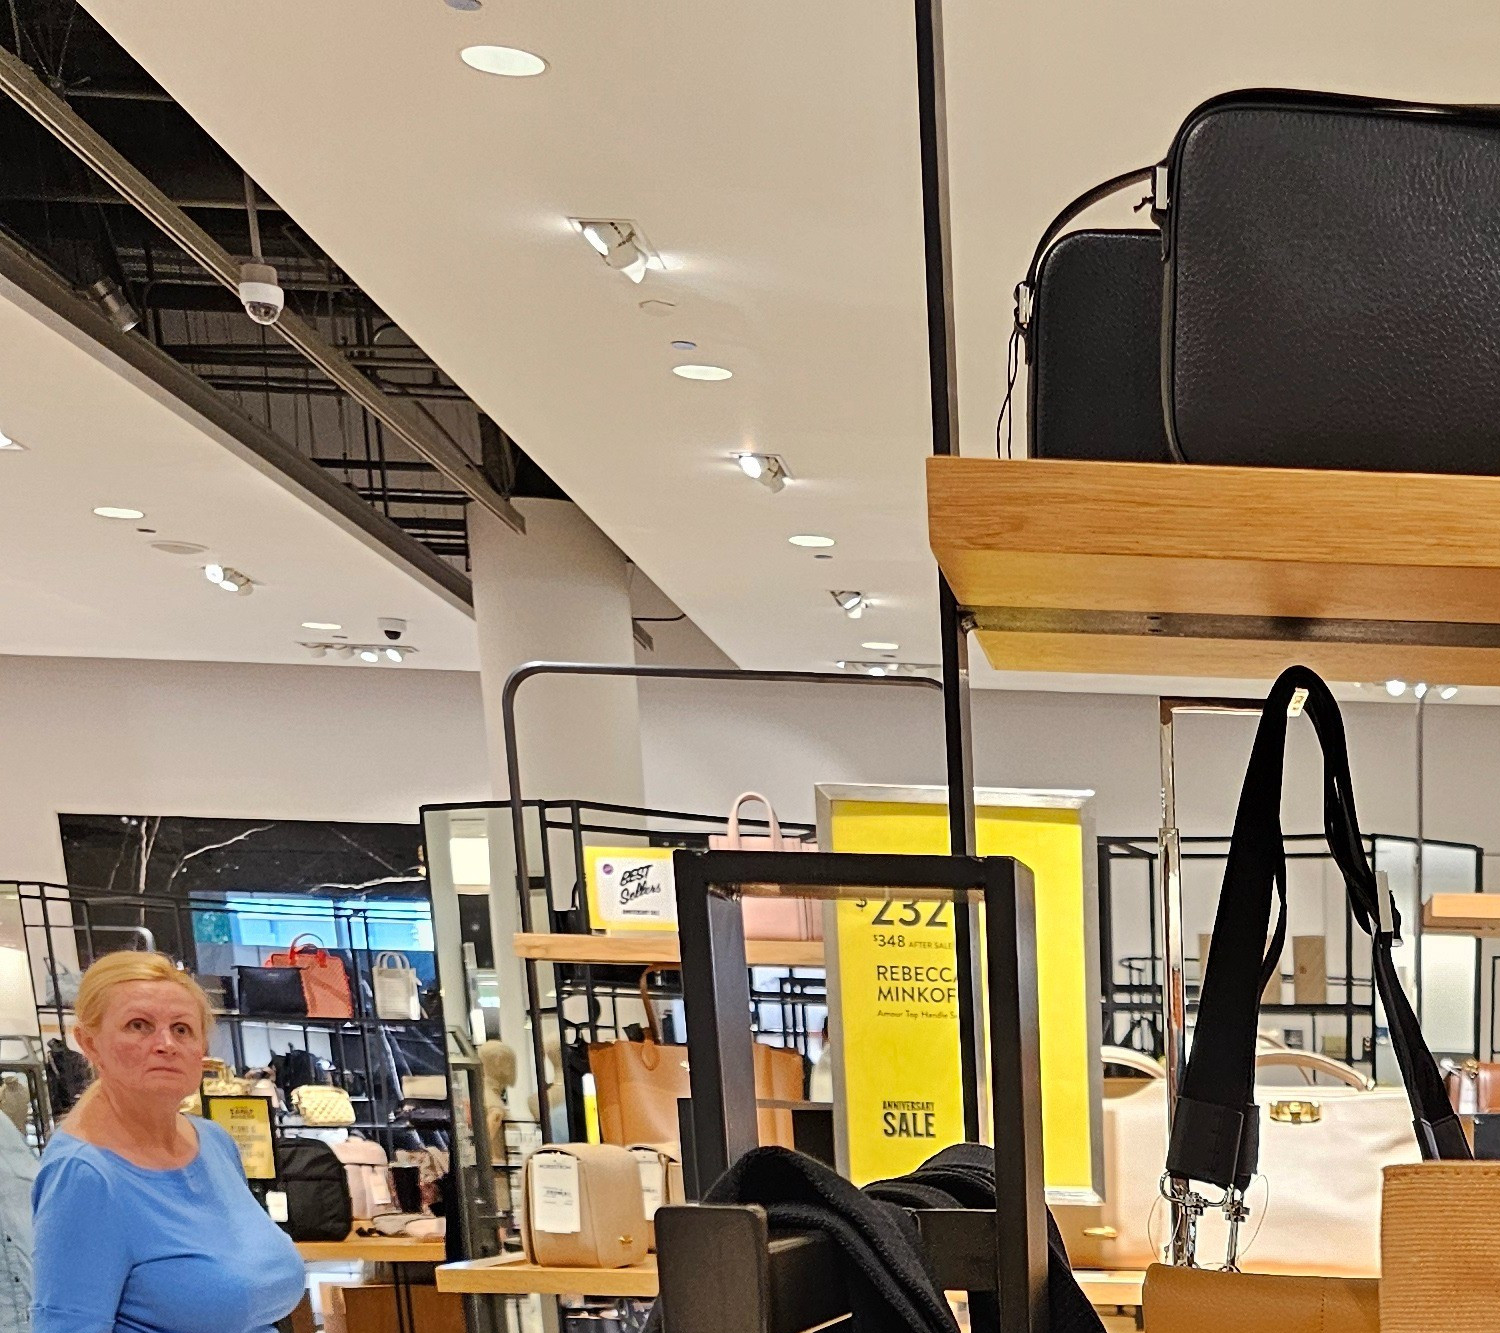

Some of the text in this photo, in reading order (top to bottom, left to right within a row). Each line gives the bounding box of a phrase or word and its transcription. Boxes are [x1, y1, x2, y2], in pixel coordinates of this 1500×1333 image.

[620, 864, 653, 887] BEST
[620, 880, 662, 905] Sellers
[873, 934, 906, 948] $348
[908, 941, 933, 949] AFTER
[905, 1010, 919, 1020] Top
[882, 1100, 935, 1112] ANNIVERSARY
[883, 1111, 936, 1139] SALE
